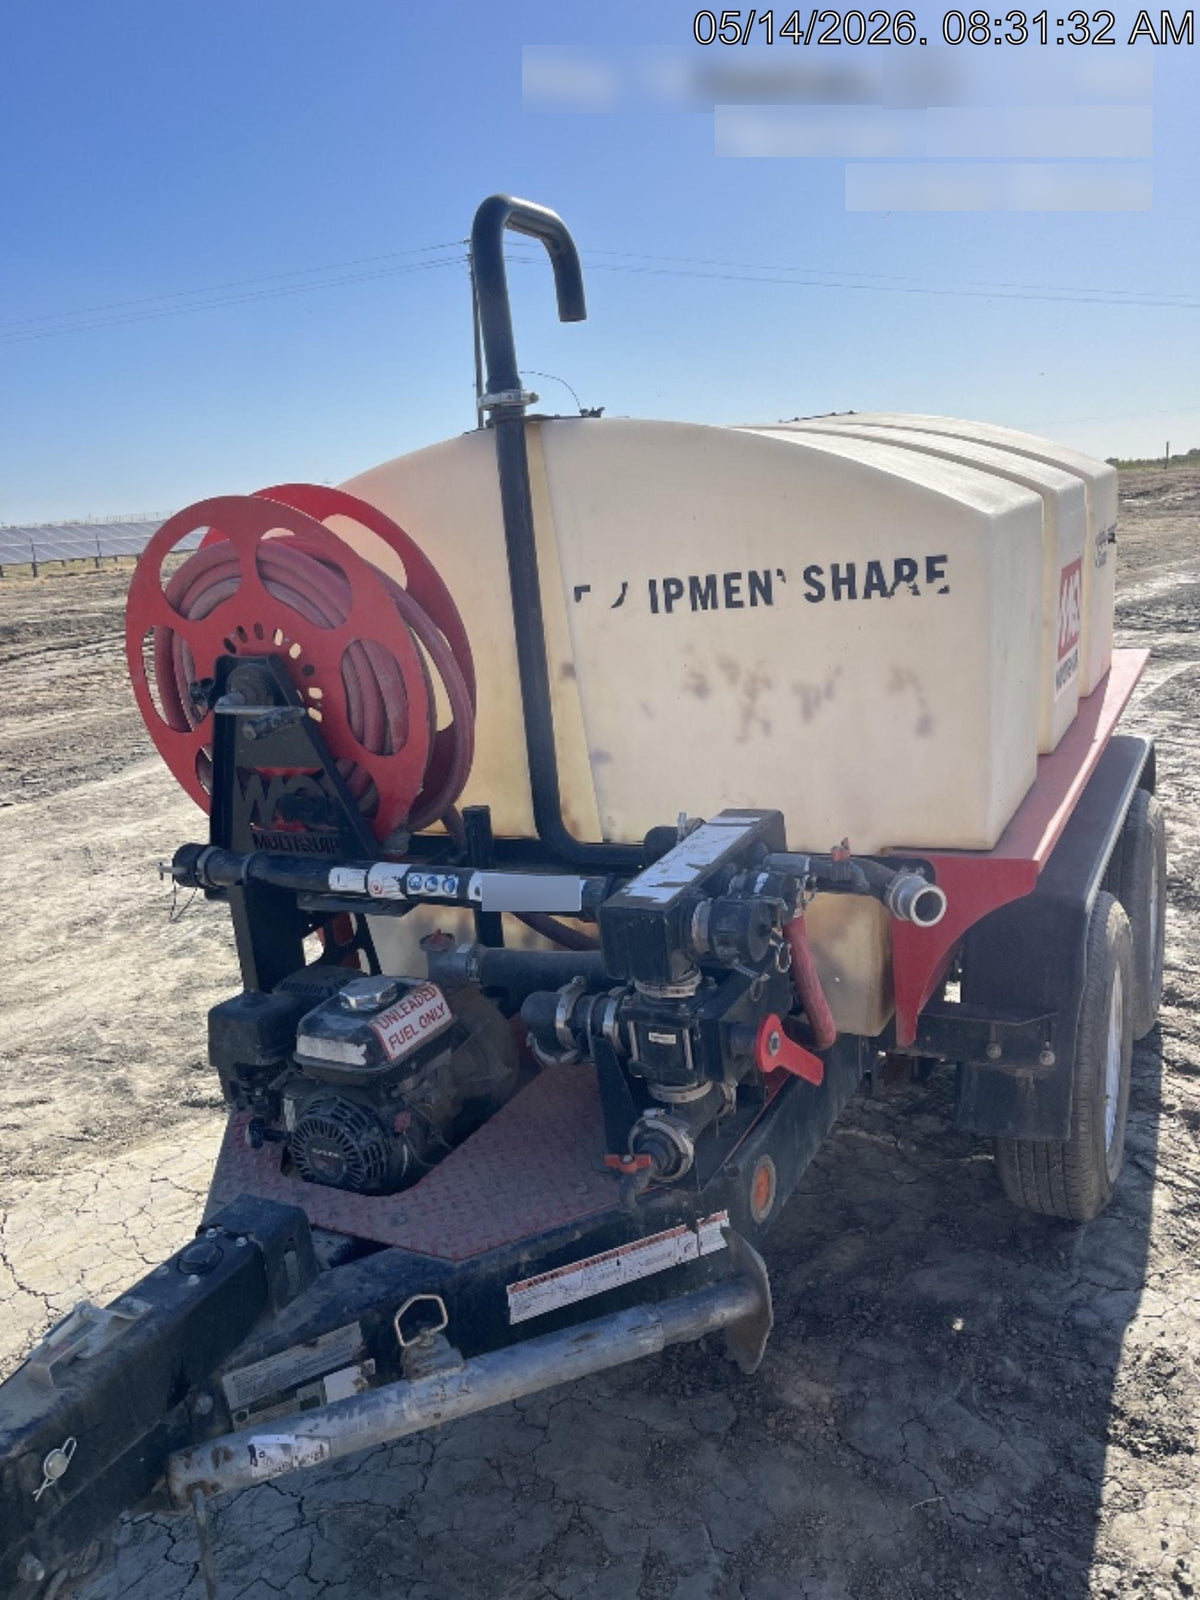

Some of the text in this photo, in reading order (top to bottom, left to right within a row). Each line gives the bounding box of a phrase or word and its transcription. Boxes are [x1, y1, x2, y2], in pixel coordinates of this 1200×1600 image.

[573, 554, 950, 614] IPMEN SHARE
[376, 984, 438, 1030] UNLEADED
[388, 1002, 446, 1051] FUEL ONLY
